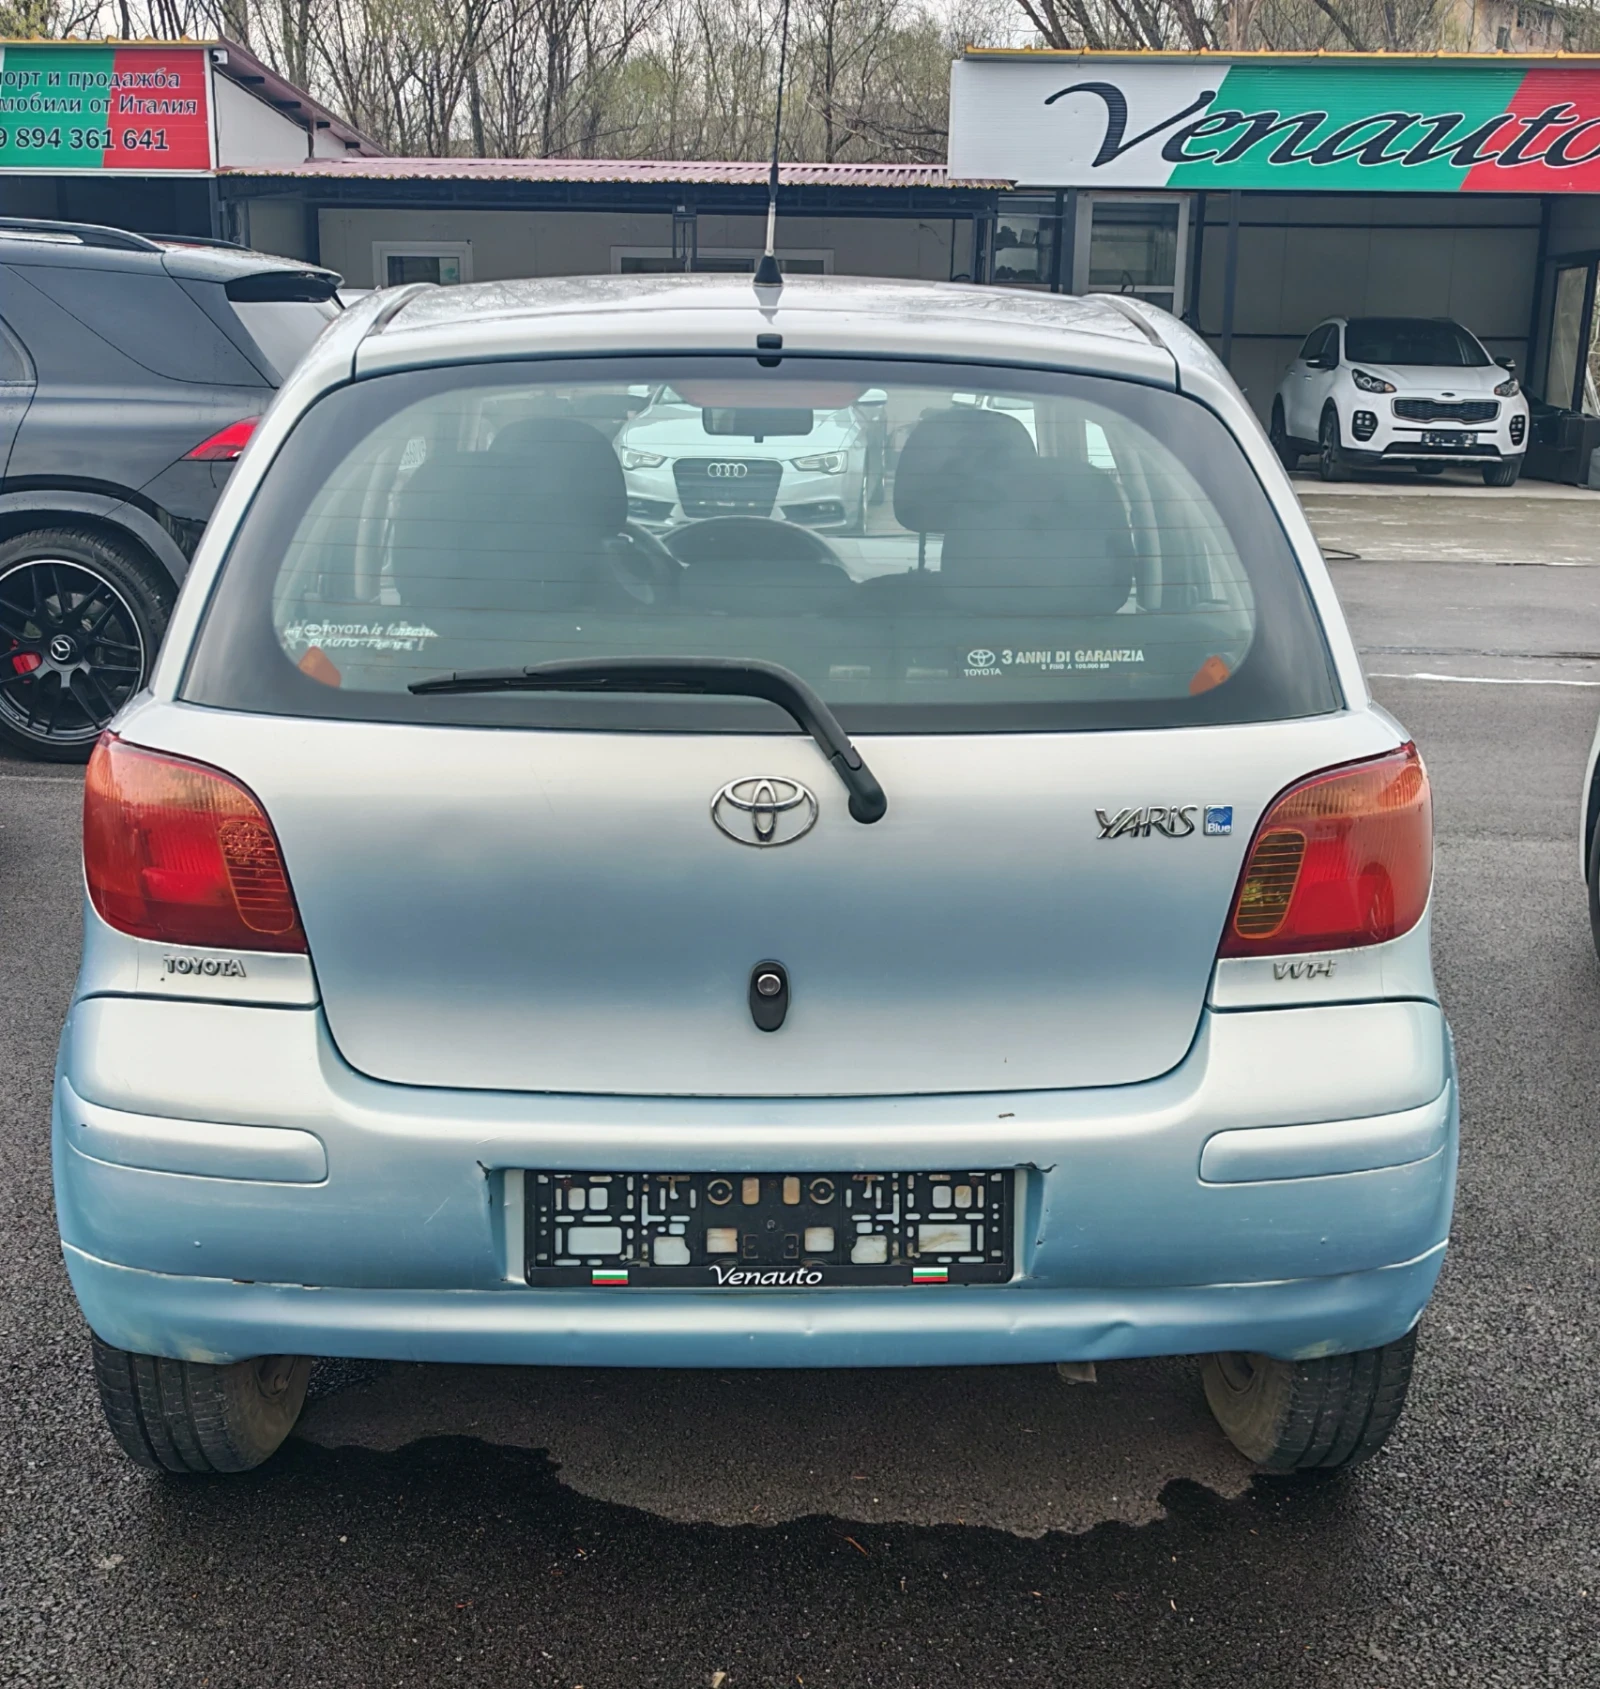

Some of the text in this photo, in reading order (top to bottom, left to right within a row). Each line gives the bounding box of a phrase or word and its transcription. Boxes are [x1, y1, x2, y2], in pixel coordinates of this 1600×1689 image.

[48, 71, 60, 87] и
[68, 67, 180, 91] продажба
[89, 99, 113, 113] от
[119, 94, 197, 114] Италия
[1044, 81, 1600, 168] Venauto
[16, 127, 61, 148] 894
[69, 127, 115, 149] 361
[123, 128, 169, 150] 641
[322, 623, 369, 636] TOYOTA
[1001, 649, 1145, 664] 3 ANNI DI GARANZIA
[964, 668, 1002, 677] TOYOTA
[1207, 823, 1231, 833] Blue
[163, 954, 246, 978] TOYOTA
[709, 1265, 823, 1285] Venauto
